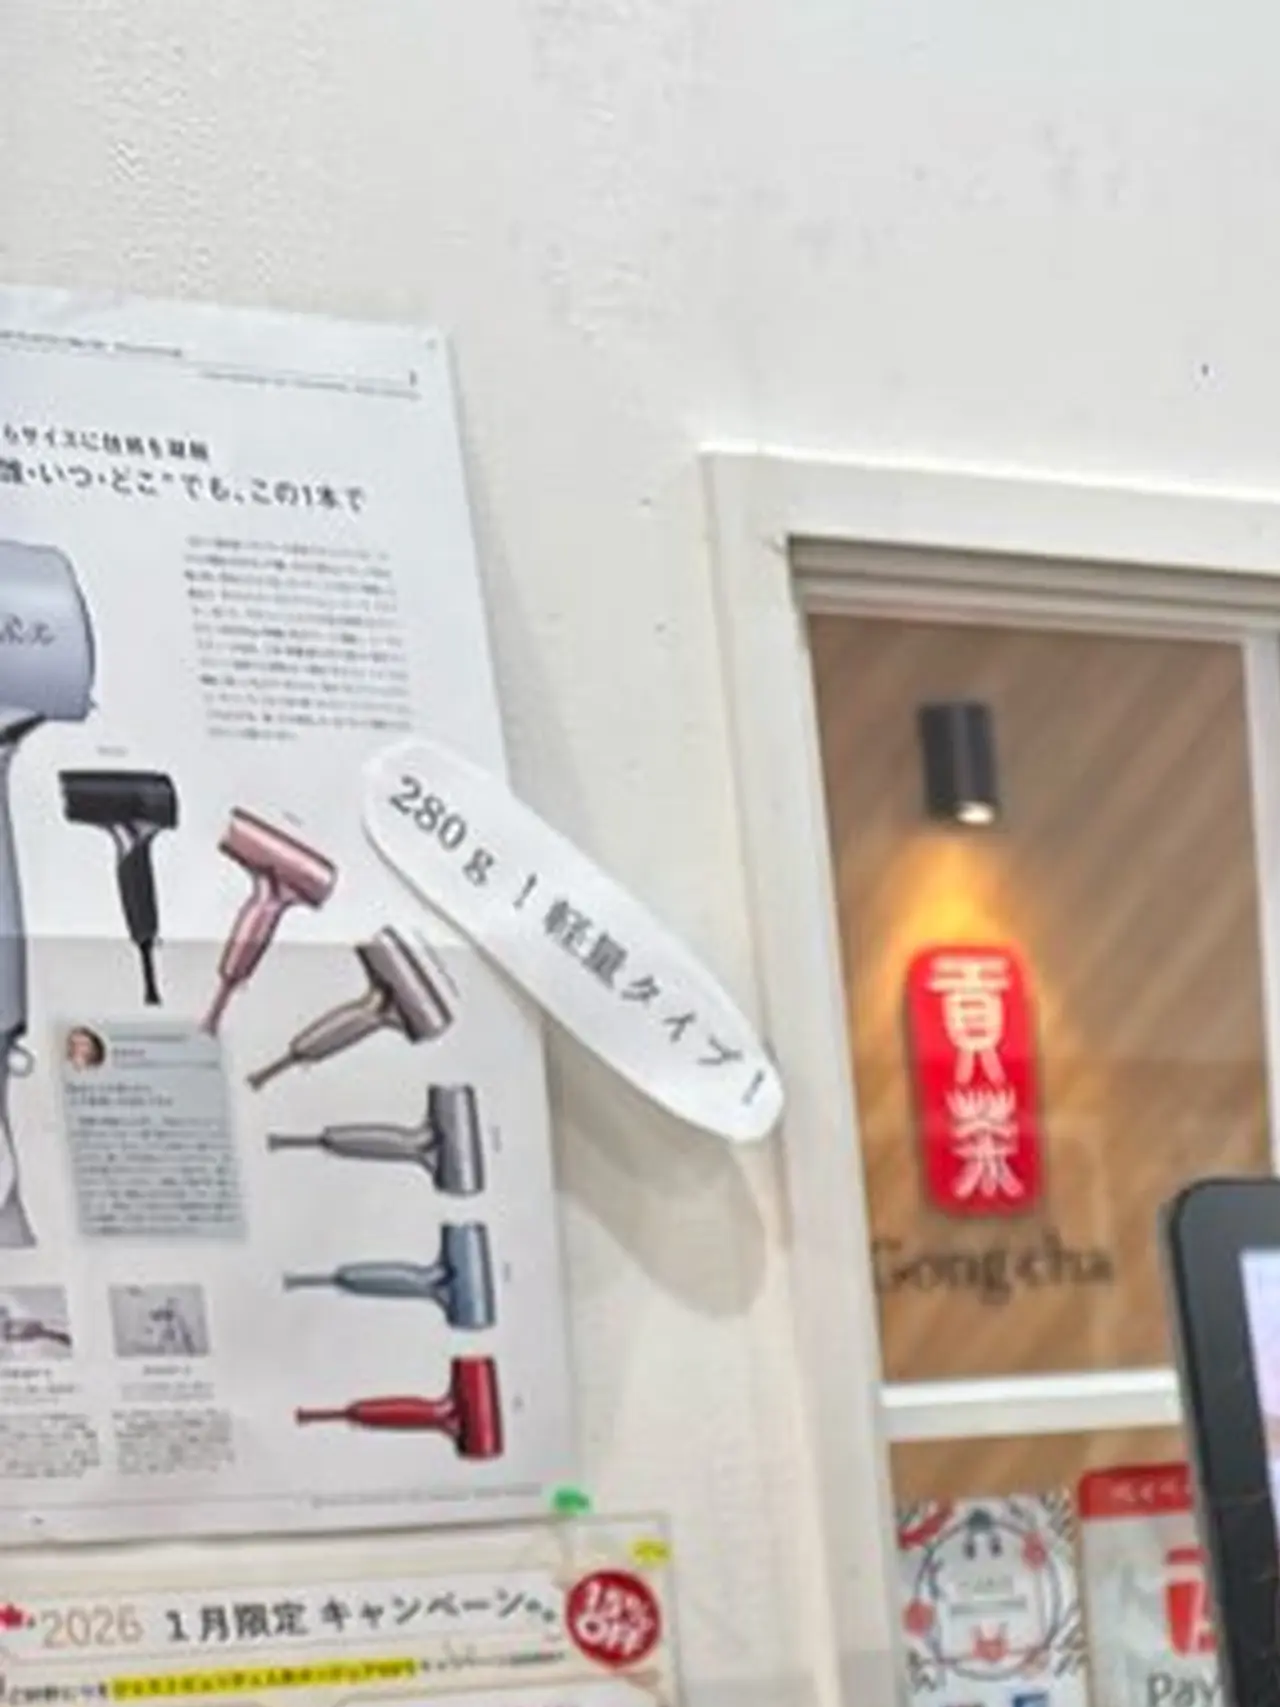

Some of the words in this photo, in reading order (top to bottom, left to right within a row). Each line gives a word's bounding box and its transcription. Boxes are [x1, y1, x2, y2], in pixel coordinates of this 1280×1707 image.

[40, 1606, 144, 1647] 2026
[165, 1601, 309, 1642] 1月限定
[320, 1586, 524, 1632] キャンペーン
